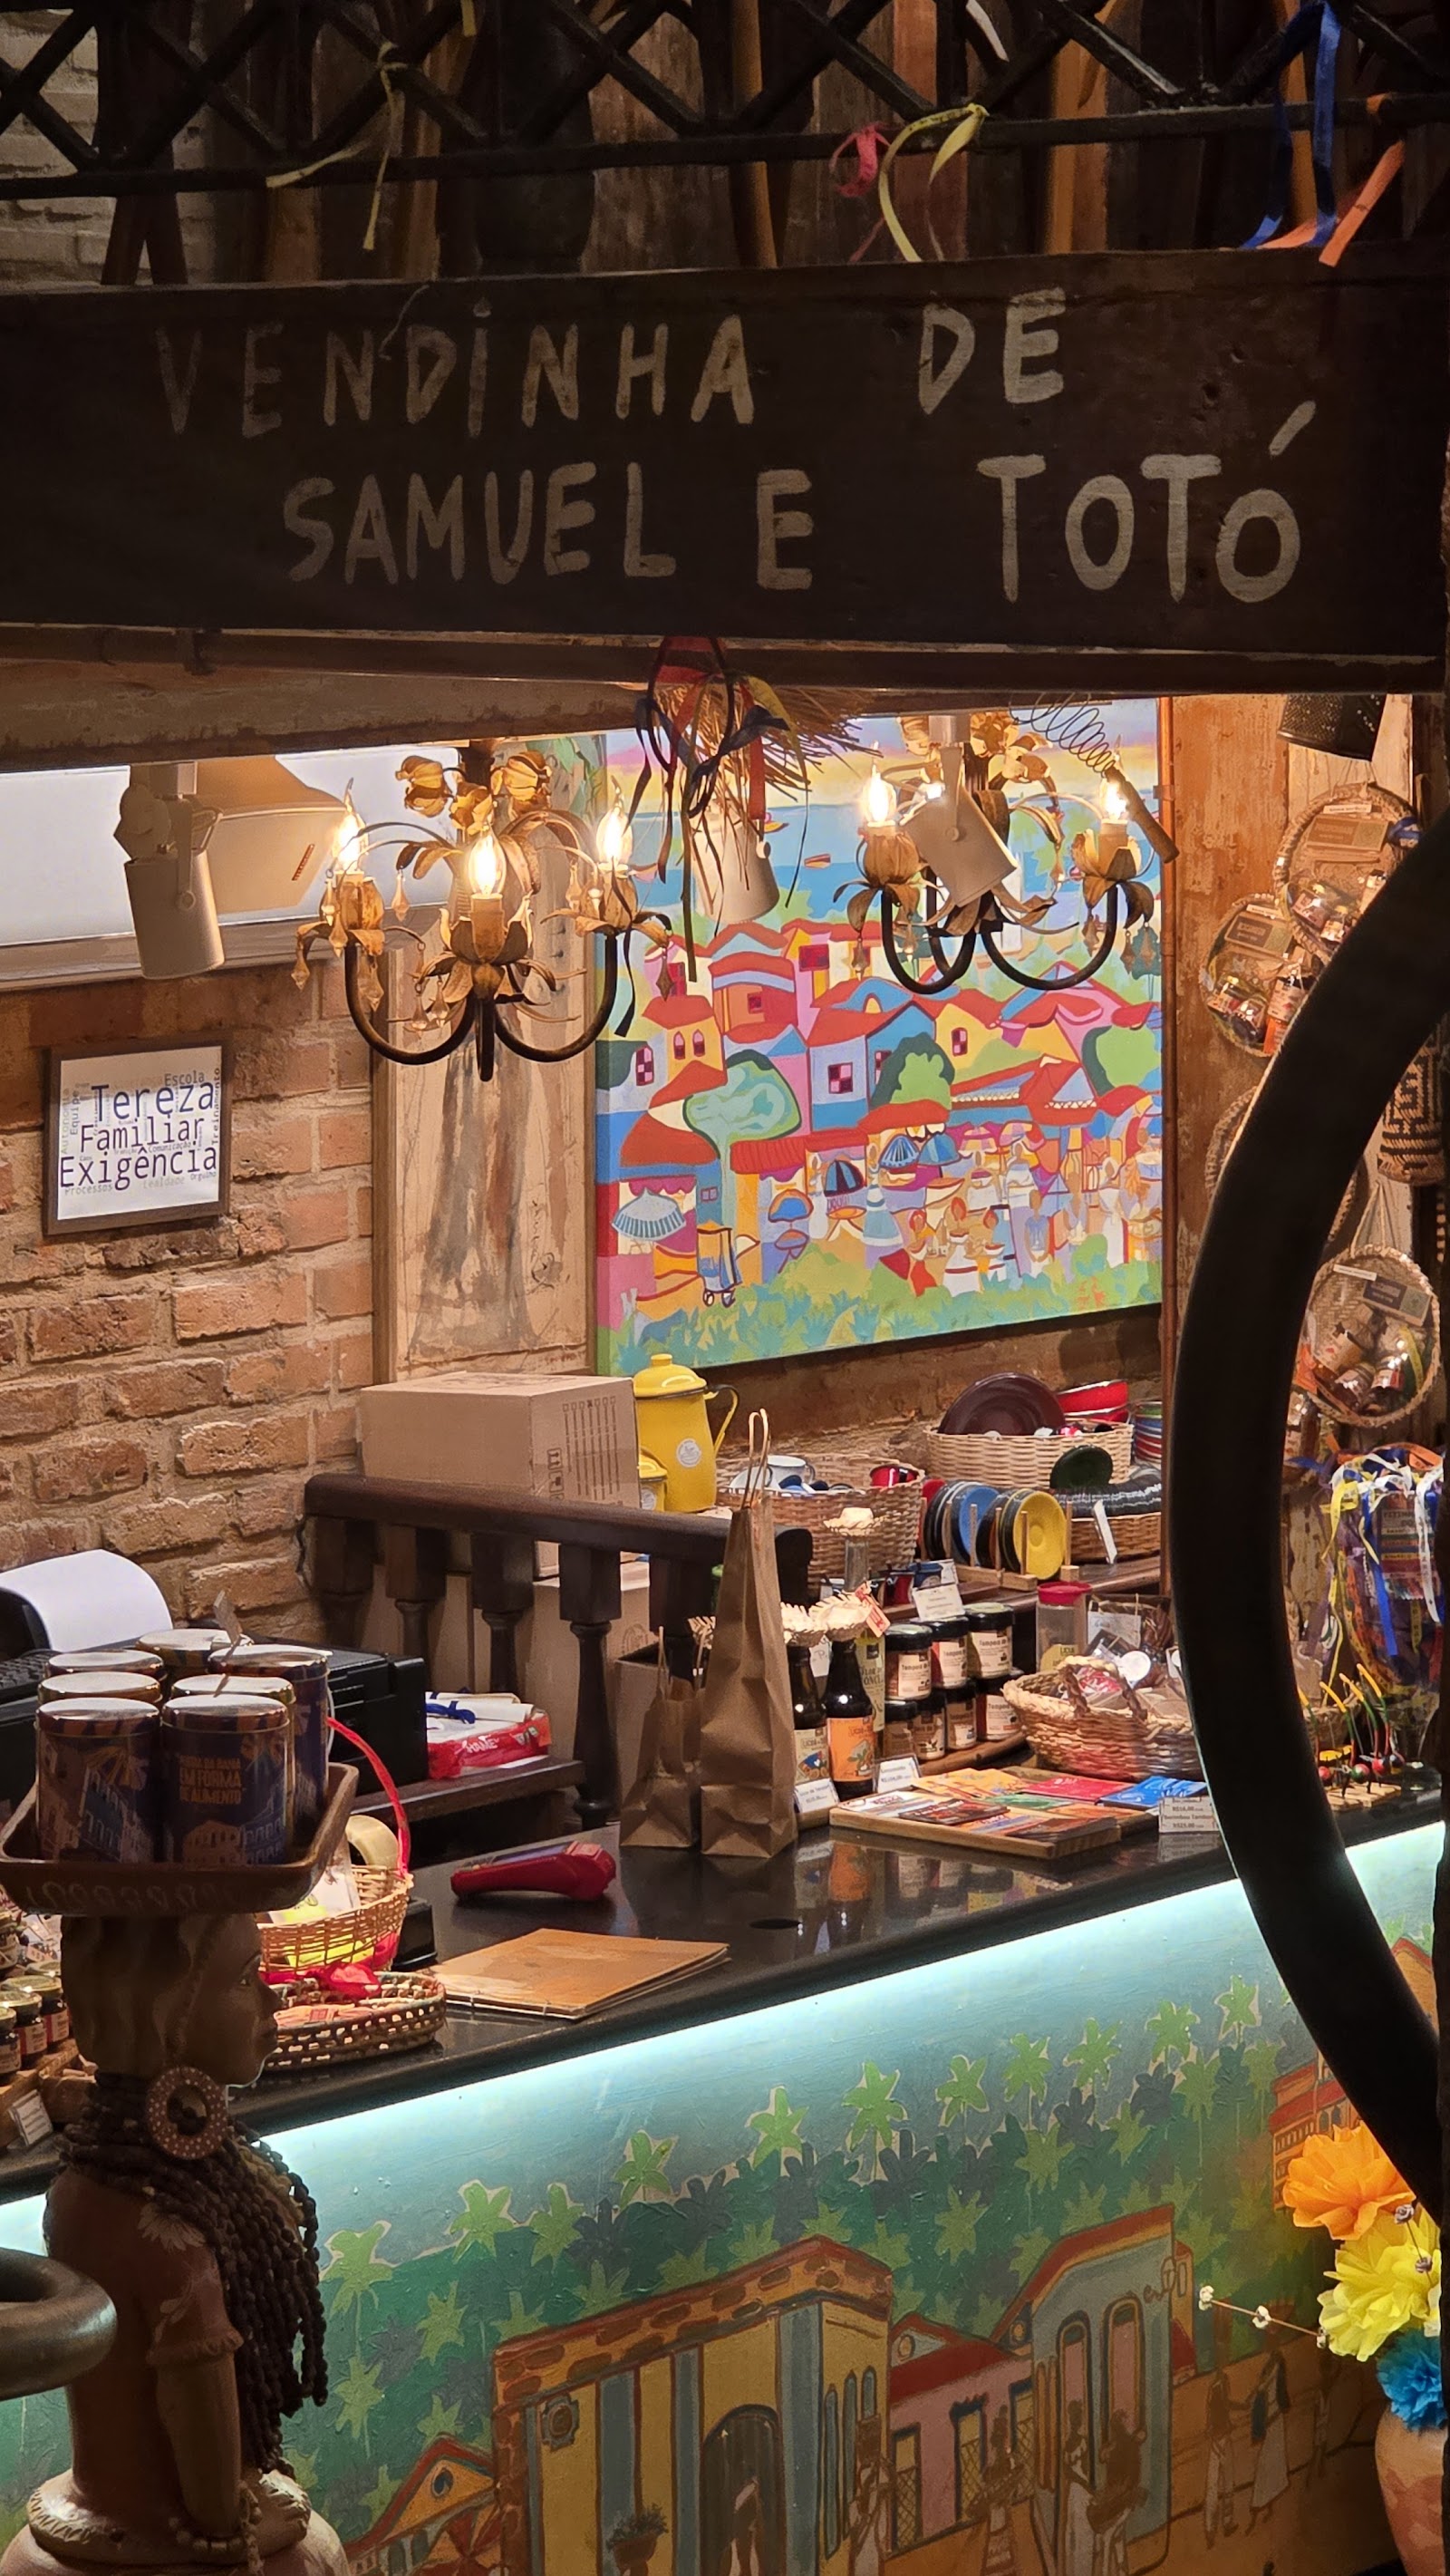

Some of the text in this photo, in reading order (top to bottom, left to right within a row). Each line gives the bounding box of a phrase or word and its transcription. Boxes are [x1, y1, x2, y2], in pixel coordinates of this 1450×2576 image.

[918, 287, 1066, 414] DE
[283, 400, 1317, 603] SAMUEL E TOTÓ
[164, 1070, 205, 1087] Escola
[70, 1089, 81, 1137] Equipe
[91, 1081, 215, 1122] Tereza
[81, 1114, 205, 1153] Familiar
[148, 1140, 192, 1154] Comunicação
[60, 1140, 218, 1191] Exigência
[64, 1183, 113, 1196] Processos
[197, 1768, 242, 1788] FORMA
